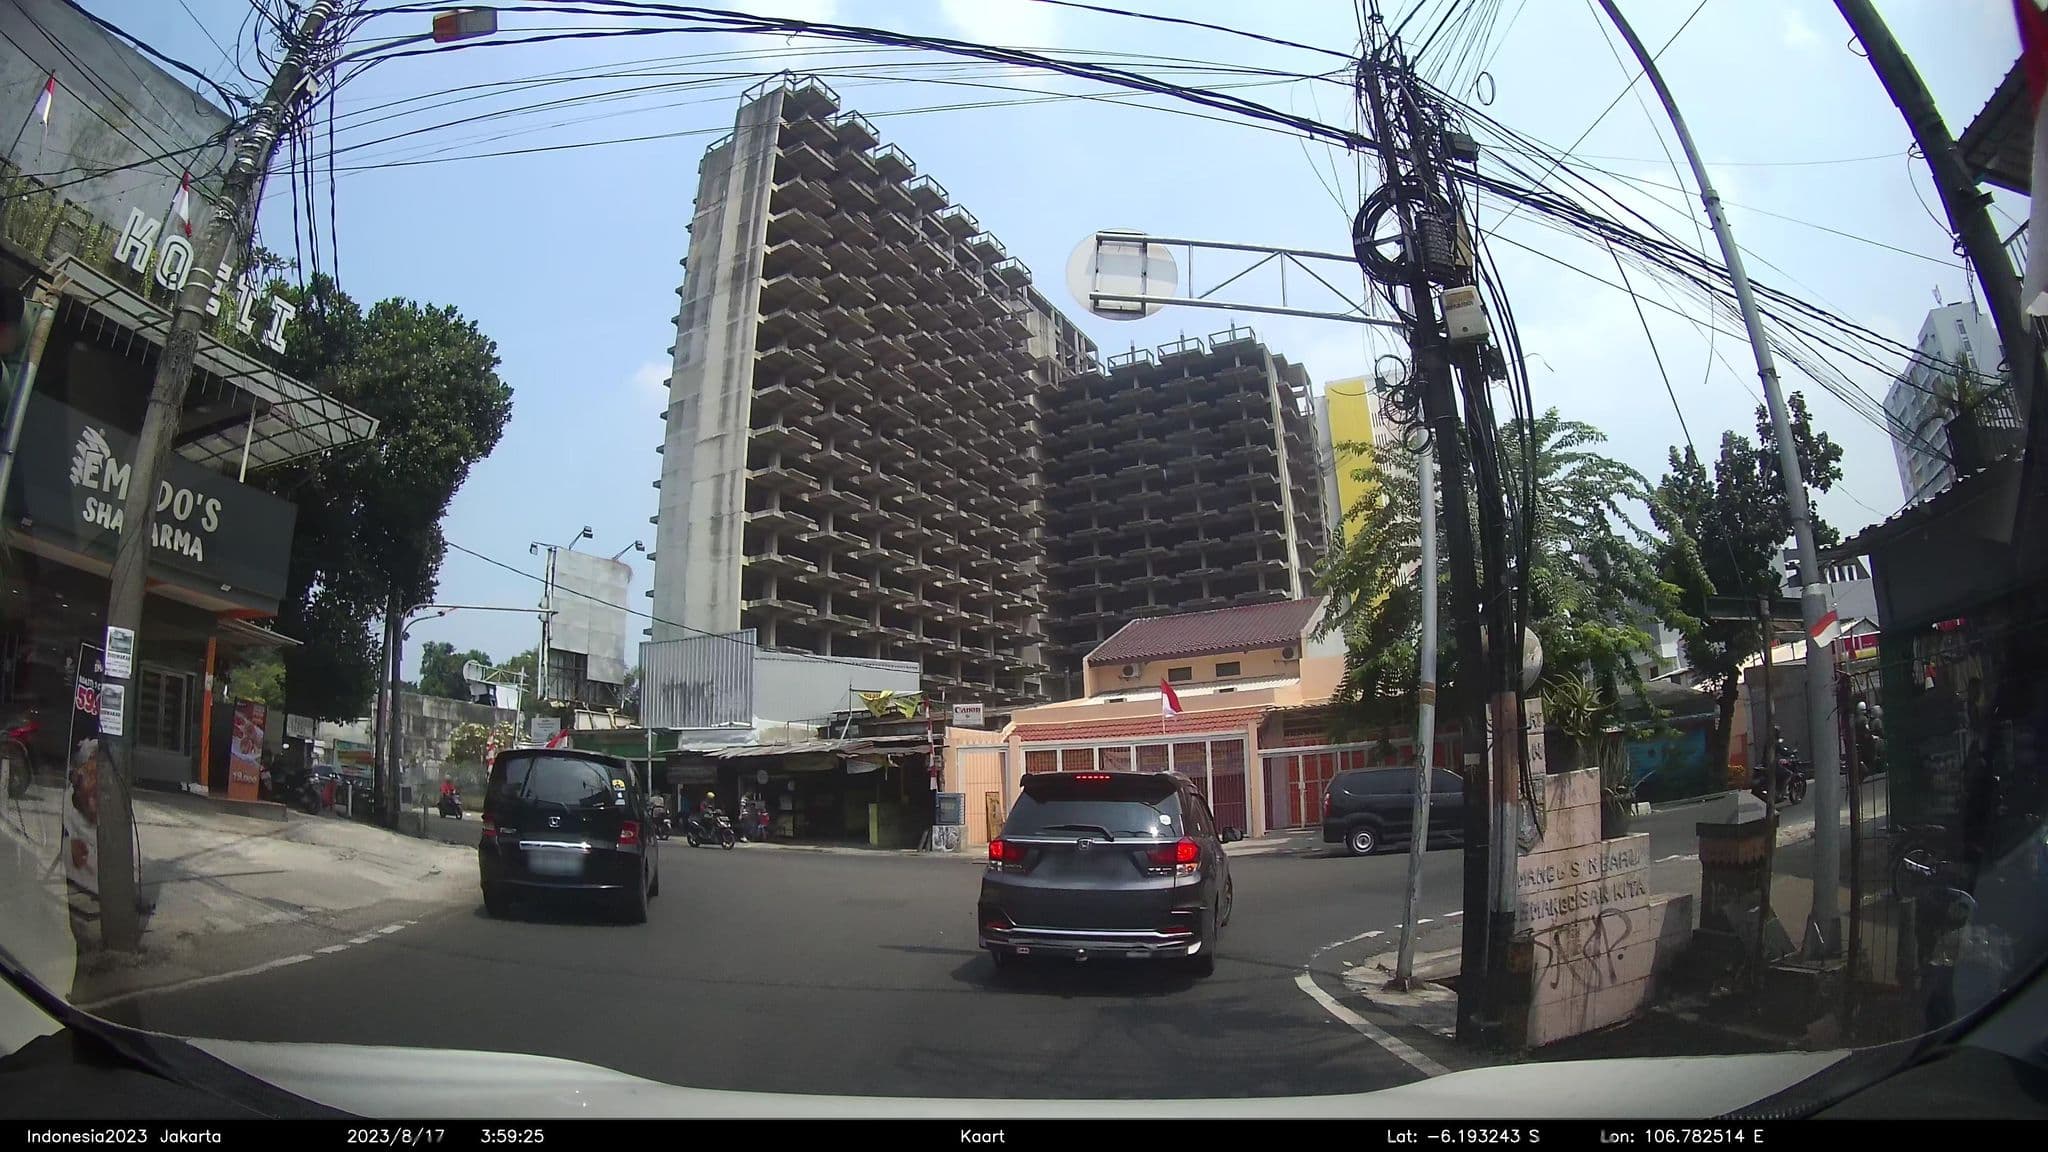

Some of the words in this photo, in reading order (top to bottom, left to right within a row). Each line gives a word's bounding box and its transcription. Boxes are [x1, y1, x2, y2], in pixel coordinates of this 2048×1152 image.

[82, 450, 222, 533] EMDO'S
[82, 497, 203, 562] SHAARMA
[955, 706, 981, 714] Canon
